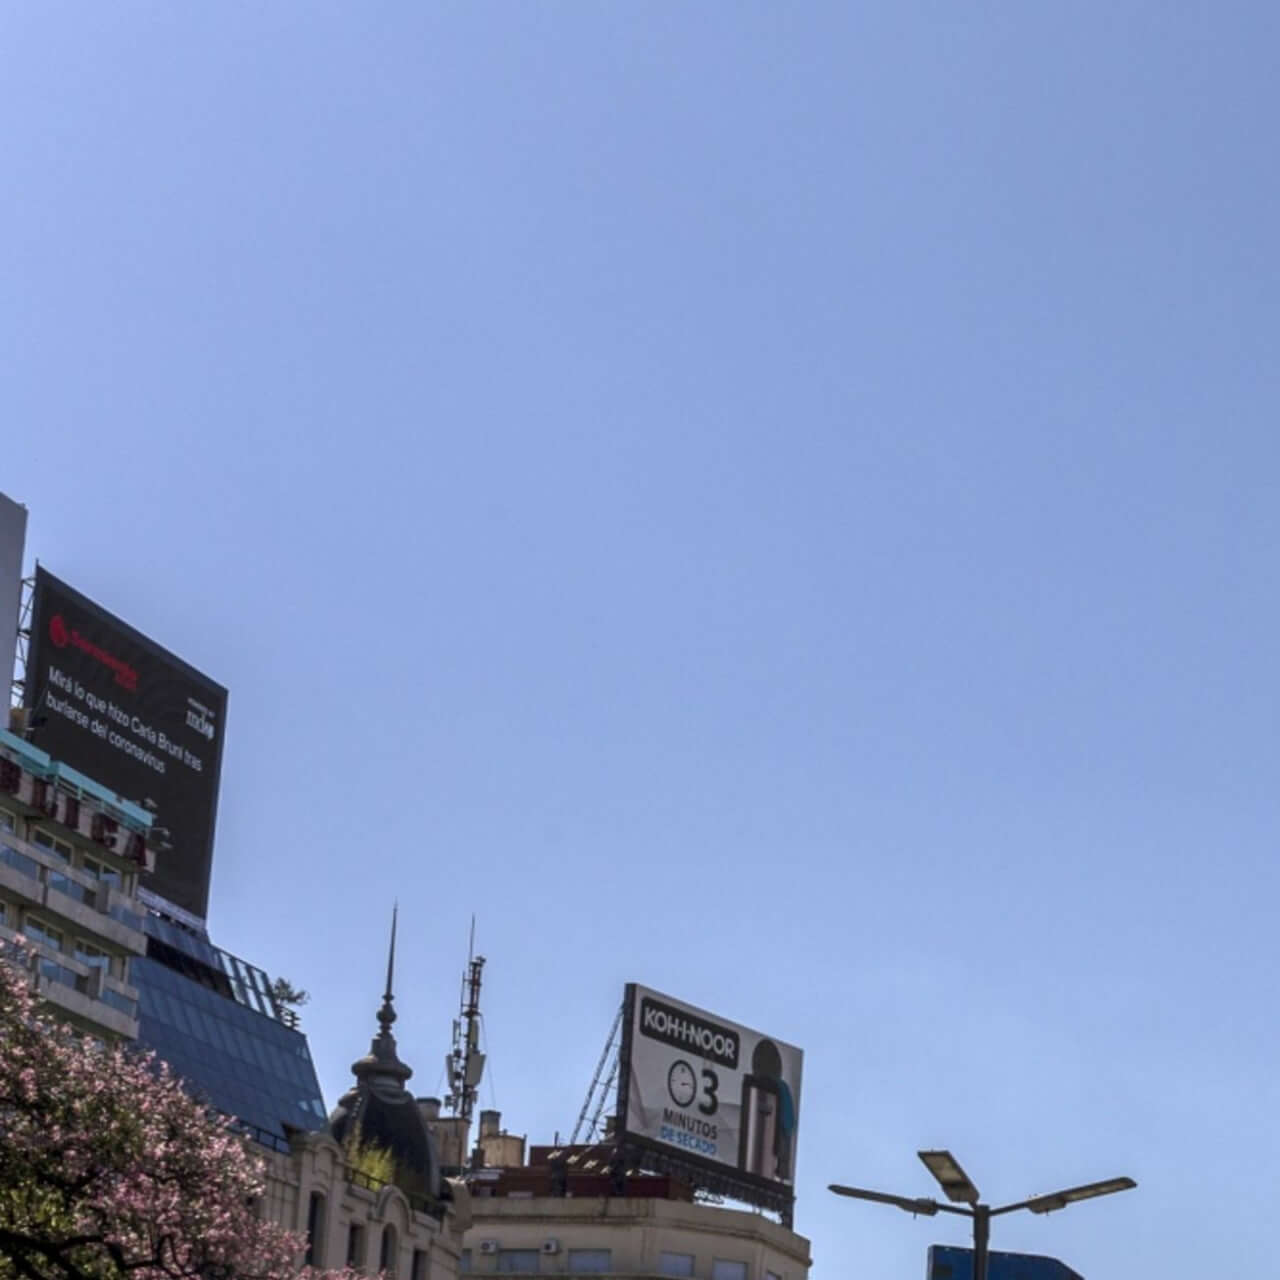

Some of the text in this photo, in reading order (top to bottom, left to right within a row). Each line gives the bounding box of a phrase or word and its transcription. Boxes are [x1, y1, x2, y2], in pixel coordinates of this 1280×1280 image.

[46, 690, 166, 774] burlarse del coronavirus
[49, 665, 73, 693] Mirá
[74, 685, 85, 700] lo
[86, 692, 107, 714] que
[108, 701, 130, 728] hizo
[131, 716, 156, 745] Carla
[158, 732, 183, 761] Bruni
[698, 1069, 719, 1116] 3
[660, 1125, 675, 1143] DE
[663, 1107, 718, 1140] MINUTOS
